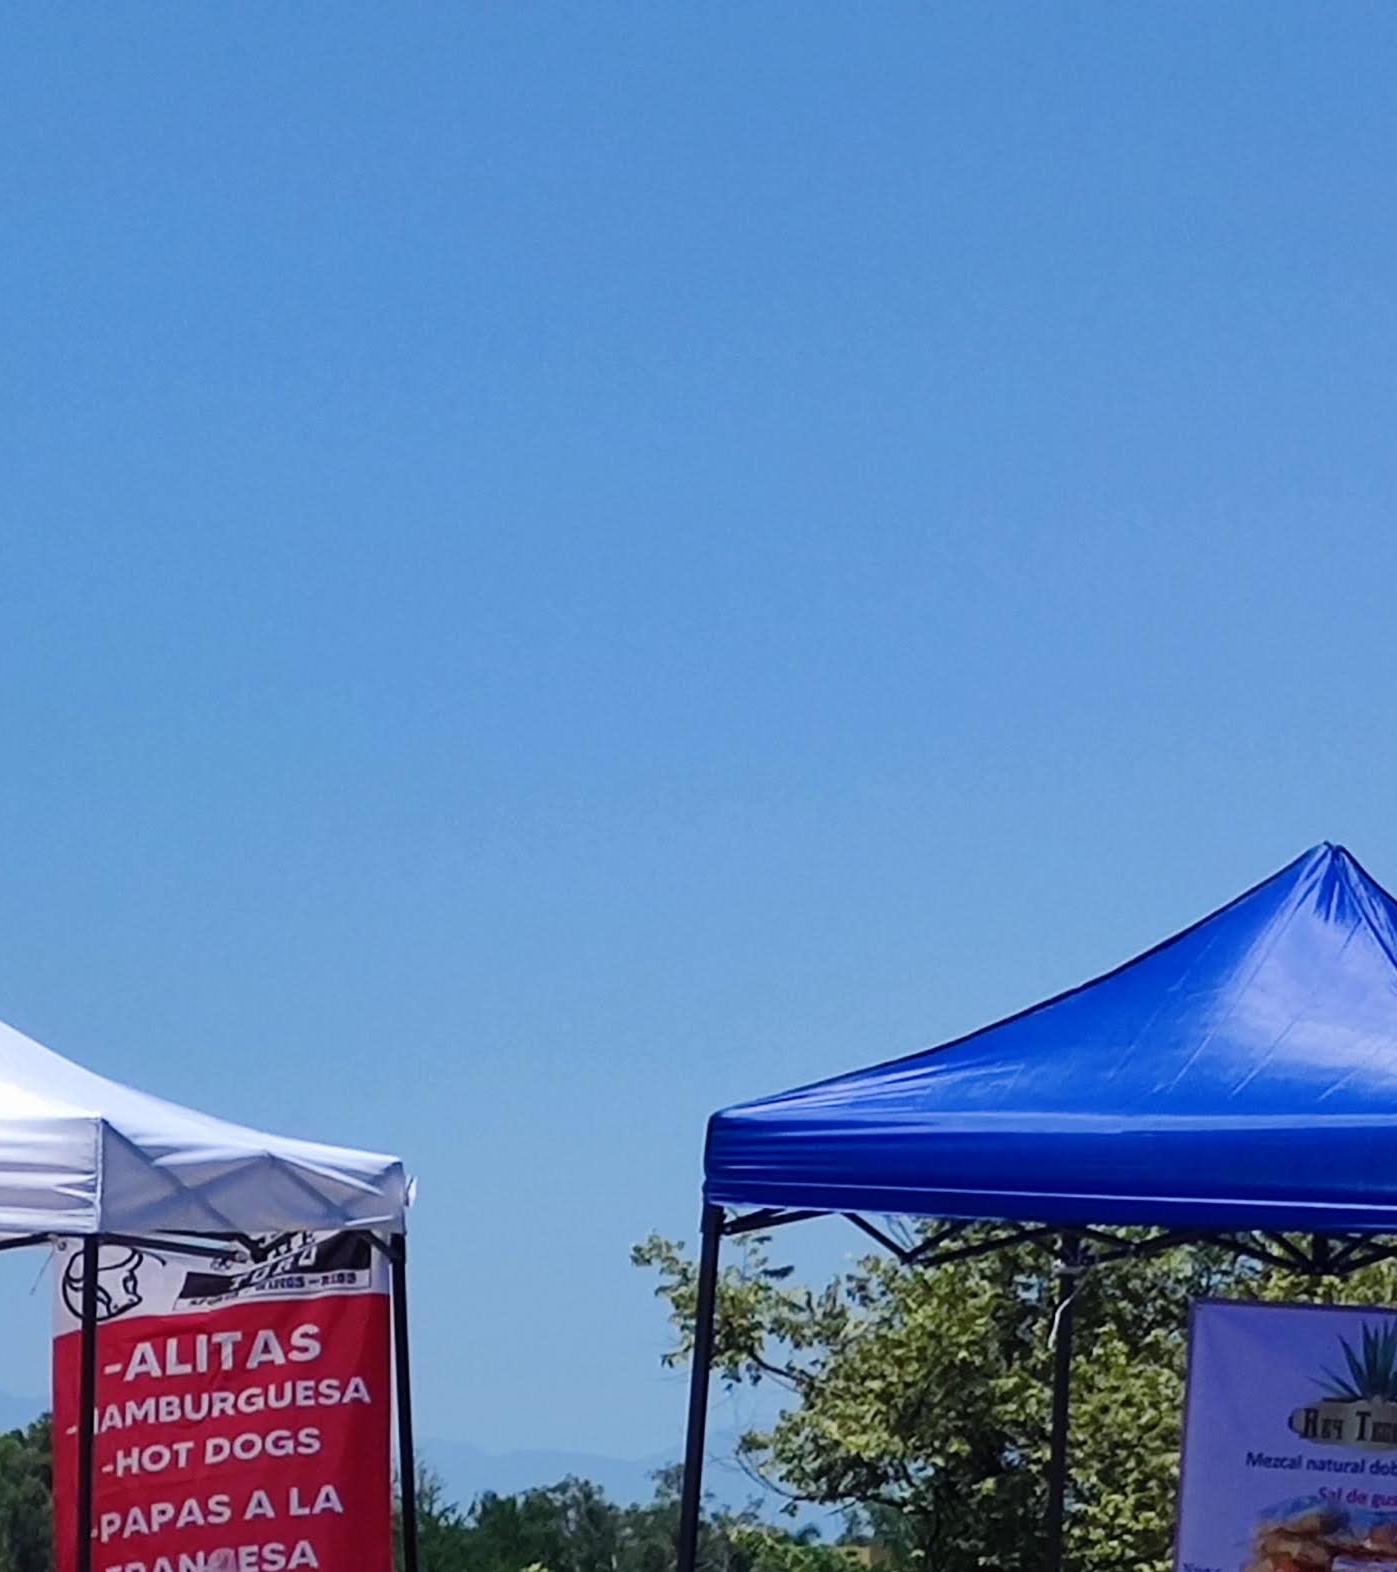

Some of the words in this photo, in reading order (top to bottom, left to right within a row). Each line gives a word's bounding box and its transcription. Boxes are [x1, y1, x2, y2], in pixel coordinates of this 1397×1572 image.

[104, 1323, 323, 1382] -ALITAS
[101, 1441, 194, 1477] -HOT
[206, 1427, 322, 1465] DOGS
[1245, 1451, 1303, 1470] Mezcal
[1306, 1458, 1365, 1473] natural
[244, 1489, 276, 1520] A
[289, 1484, 344, 1517] LA
